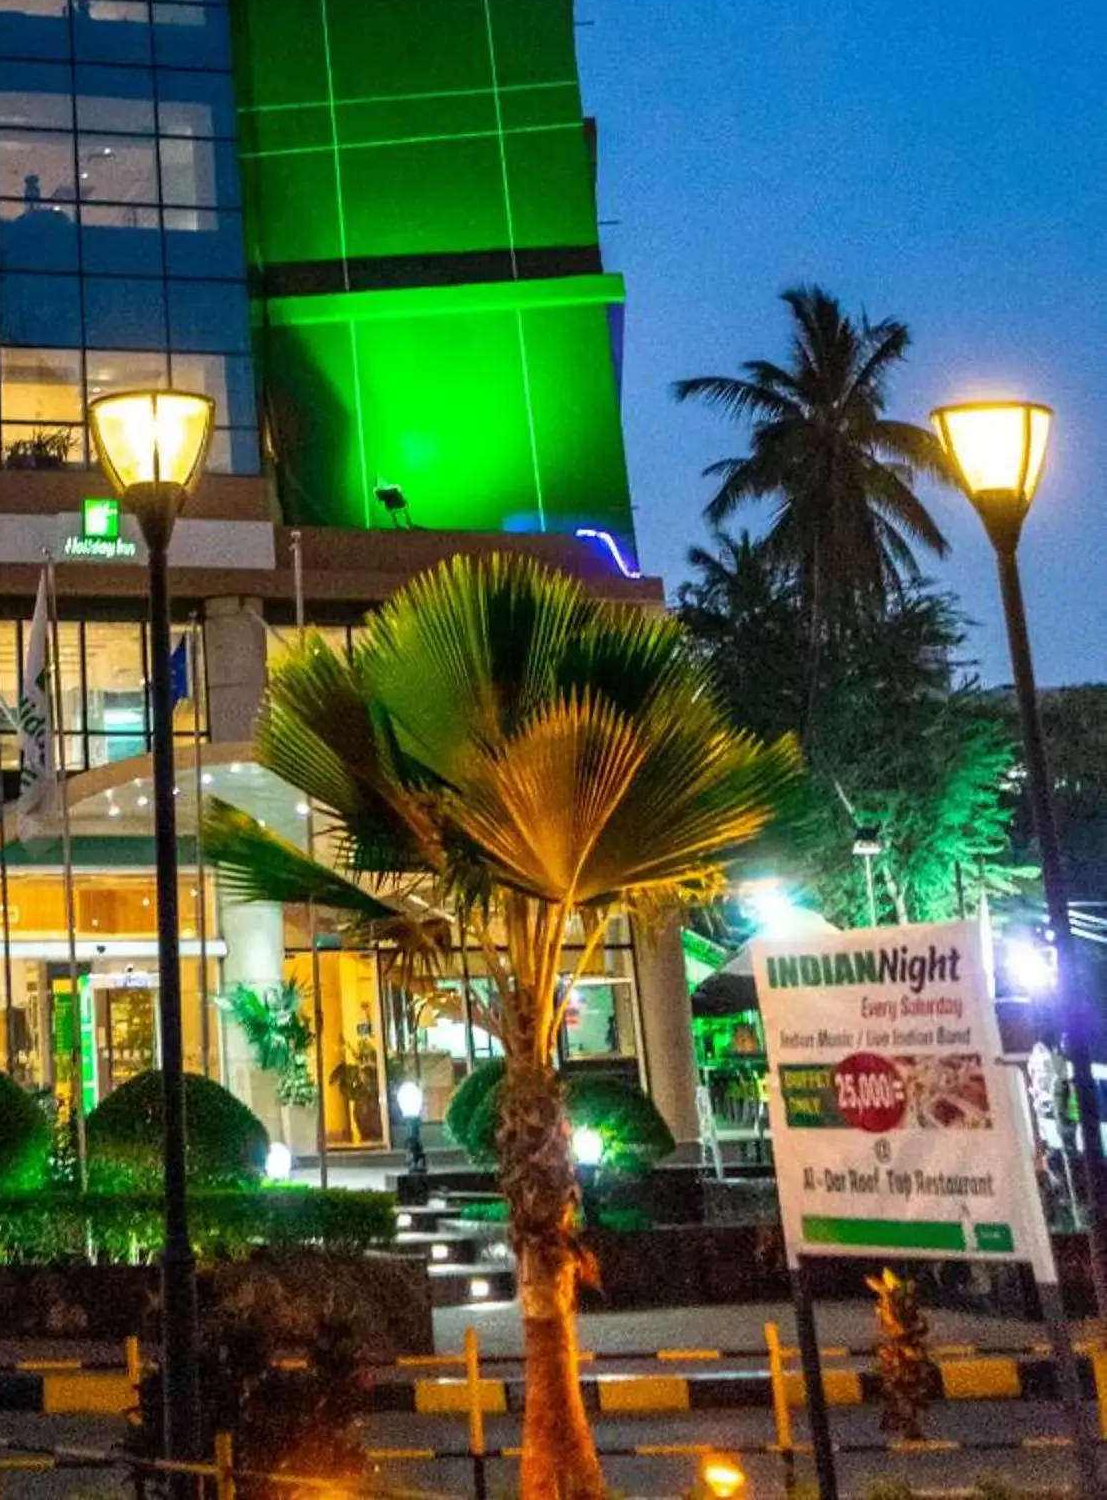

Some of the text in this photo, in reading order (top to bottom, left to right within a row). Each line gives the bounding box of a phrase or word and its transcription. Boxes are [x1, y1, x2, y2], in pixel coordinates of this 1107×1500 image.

[65, 536, 136, 558] Holiday Inn
[861, 996, 964, 1022] Every Saturday
[779, 1030, 814, 1049] Indian
[913, 1170, 995, 1199] Restaurant
